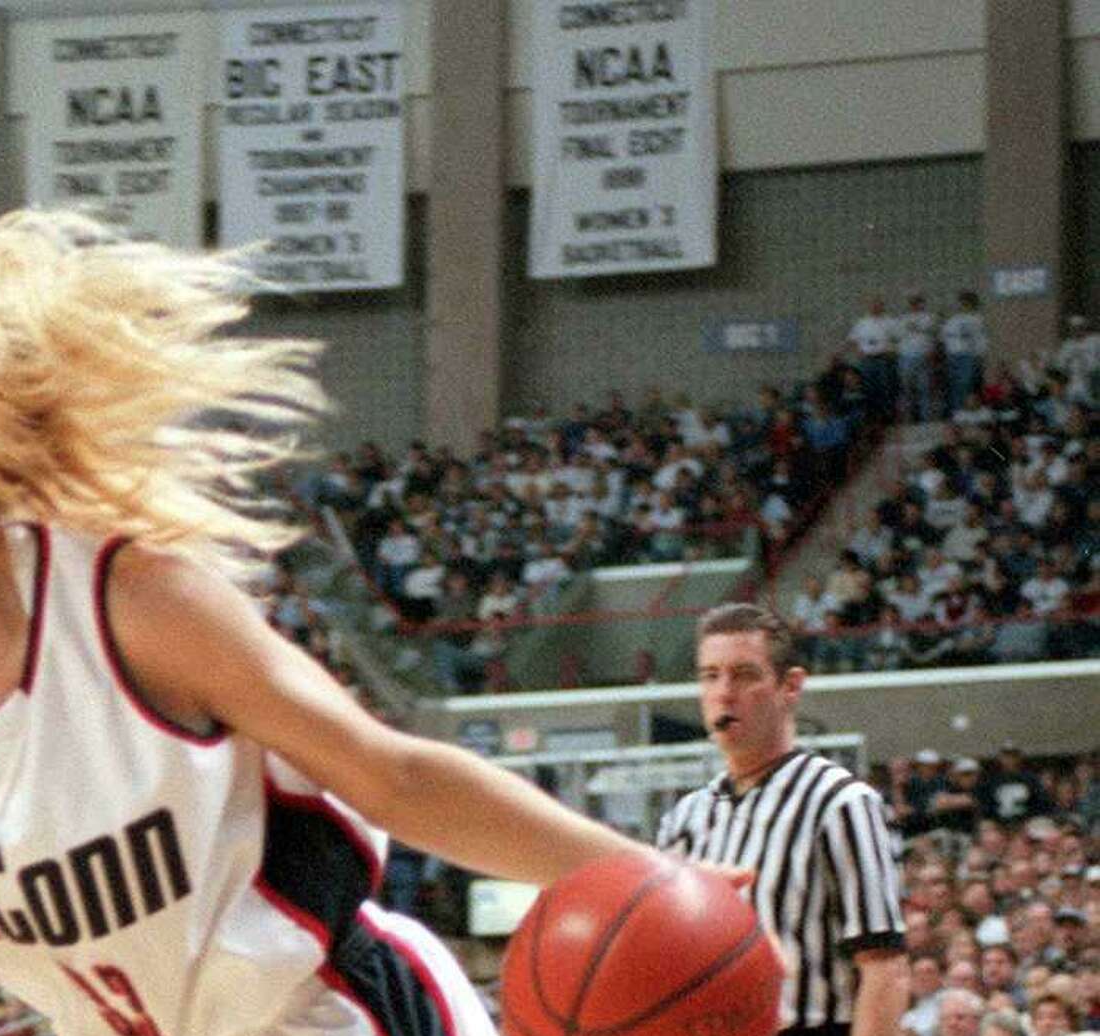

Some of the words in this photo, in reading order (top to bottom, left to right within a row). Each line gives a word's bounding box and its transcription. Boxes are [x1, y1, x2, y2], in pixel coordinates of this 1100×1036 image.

[226, 57, 282, 98] BIG
[306, 52, 401, 96] EAST
[574, 41, 675, 88] NCAA
[65, 84, 162, 127] NCAA
